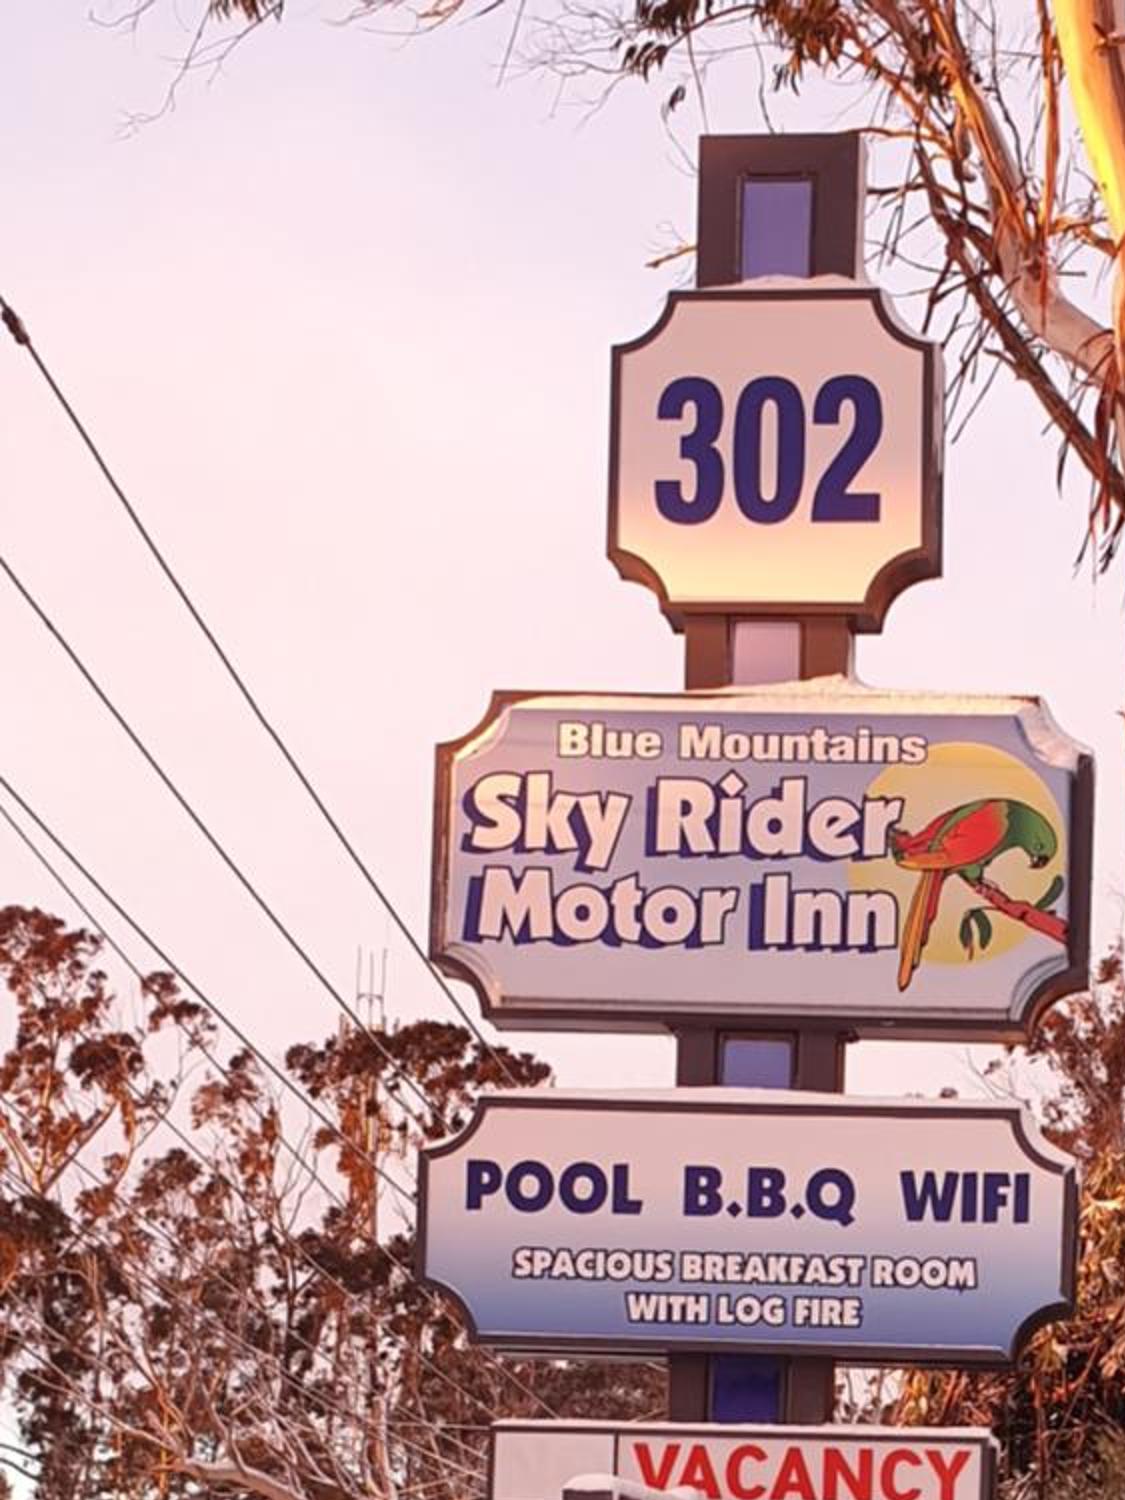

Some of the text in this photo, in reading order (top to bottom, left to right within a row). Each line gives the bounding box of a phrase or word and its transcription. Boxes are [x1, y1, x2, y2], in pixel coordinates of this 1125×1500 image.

[654, 374, 883, 526] 302
[558, 721, 928, 763] Blue Mountains
[462, 770, 904, 872] Sky Rider
[463, 865, 899, 952] Motor Inn
[466, 1160, 1030, 1226] POOL B.B.Q WIFI
[512, 1246, 977, 1289] SPACIOUS BREAKFAST ROOM
[626, 1294, 863, 1328] WITH LOG FIRE
